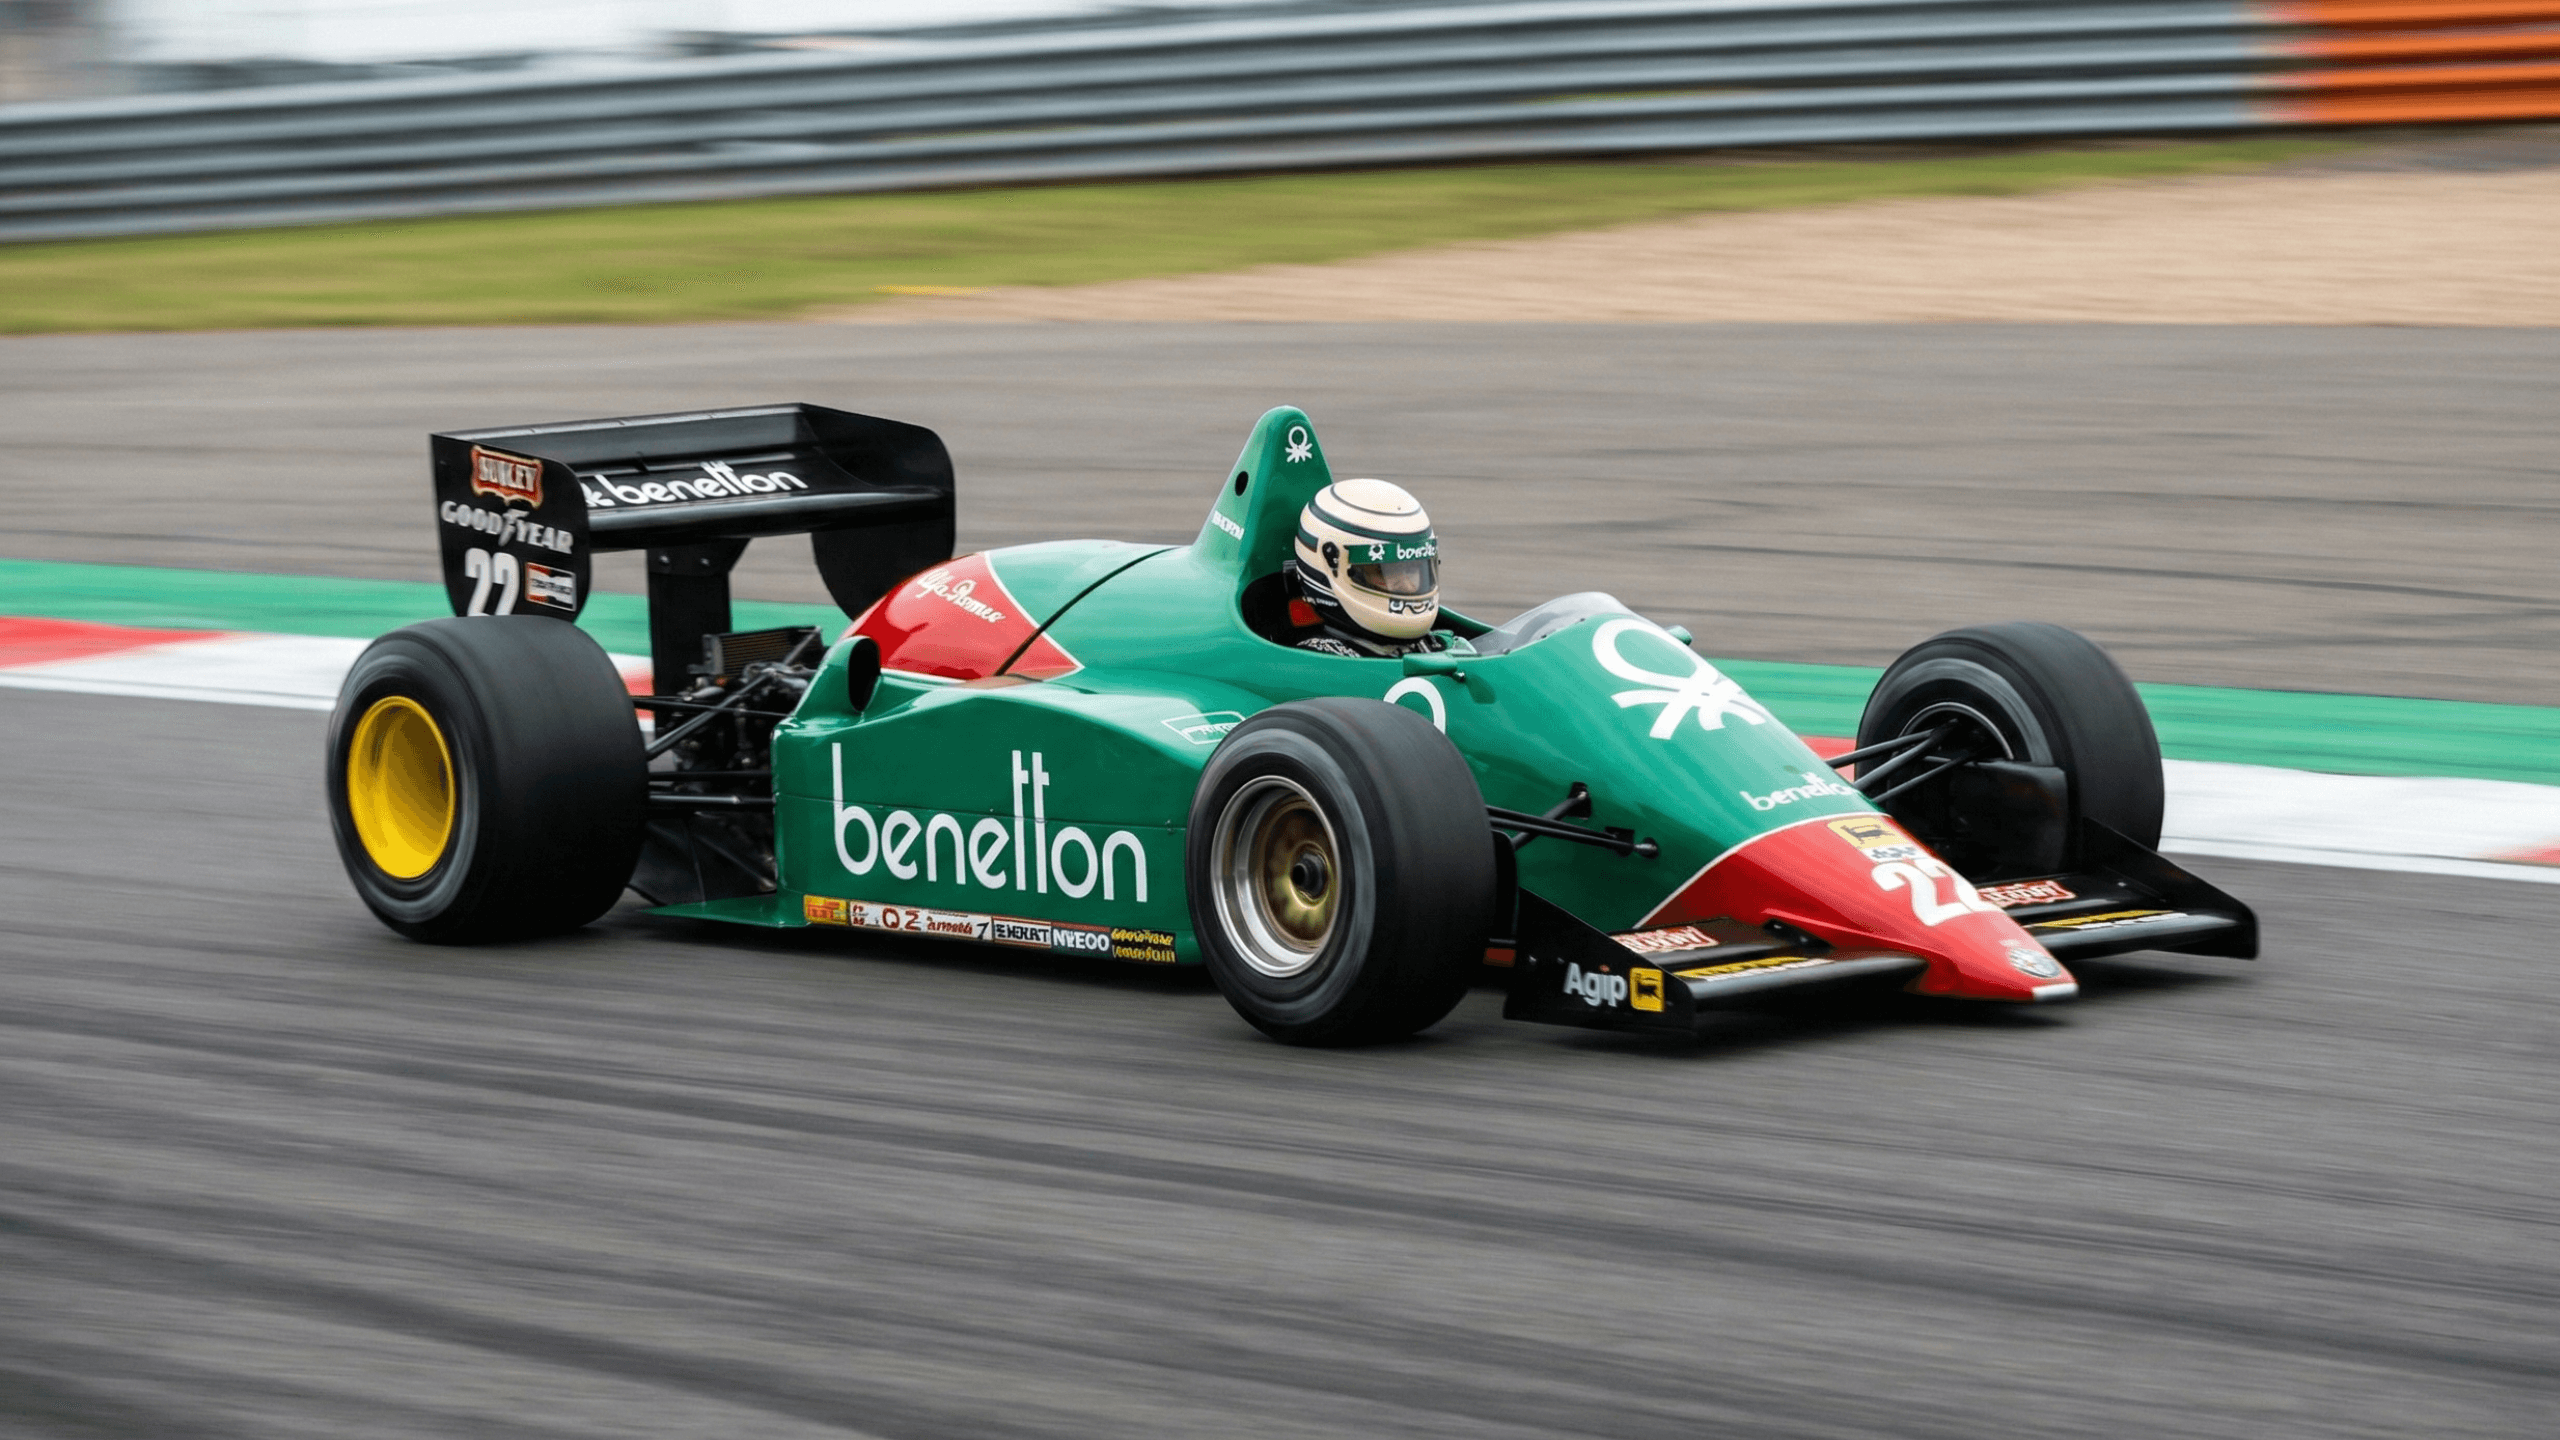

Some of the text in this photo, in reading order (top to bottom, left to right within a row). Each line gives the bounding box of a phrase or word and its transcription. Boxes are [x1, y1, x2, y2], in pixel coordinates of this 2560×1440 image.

[595, 460, 808, 504] benetton
[464, 547, 520, 617] 22
[1739, 772, 1856, 811] benetto
[831, 742, 1148, 903] benetton
[1563, 961, 1629, 1008] Agip
